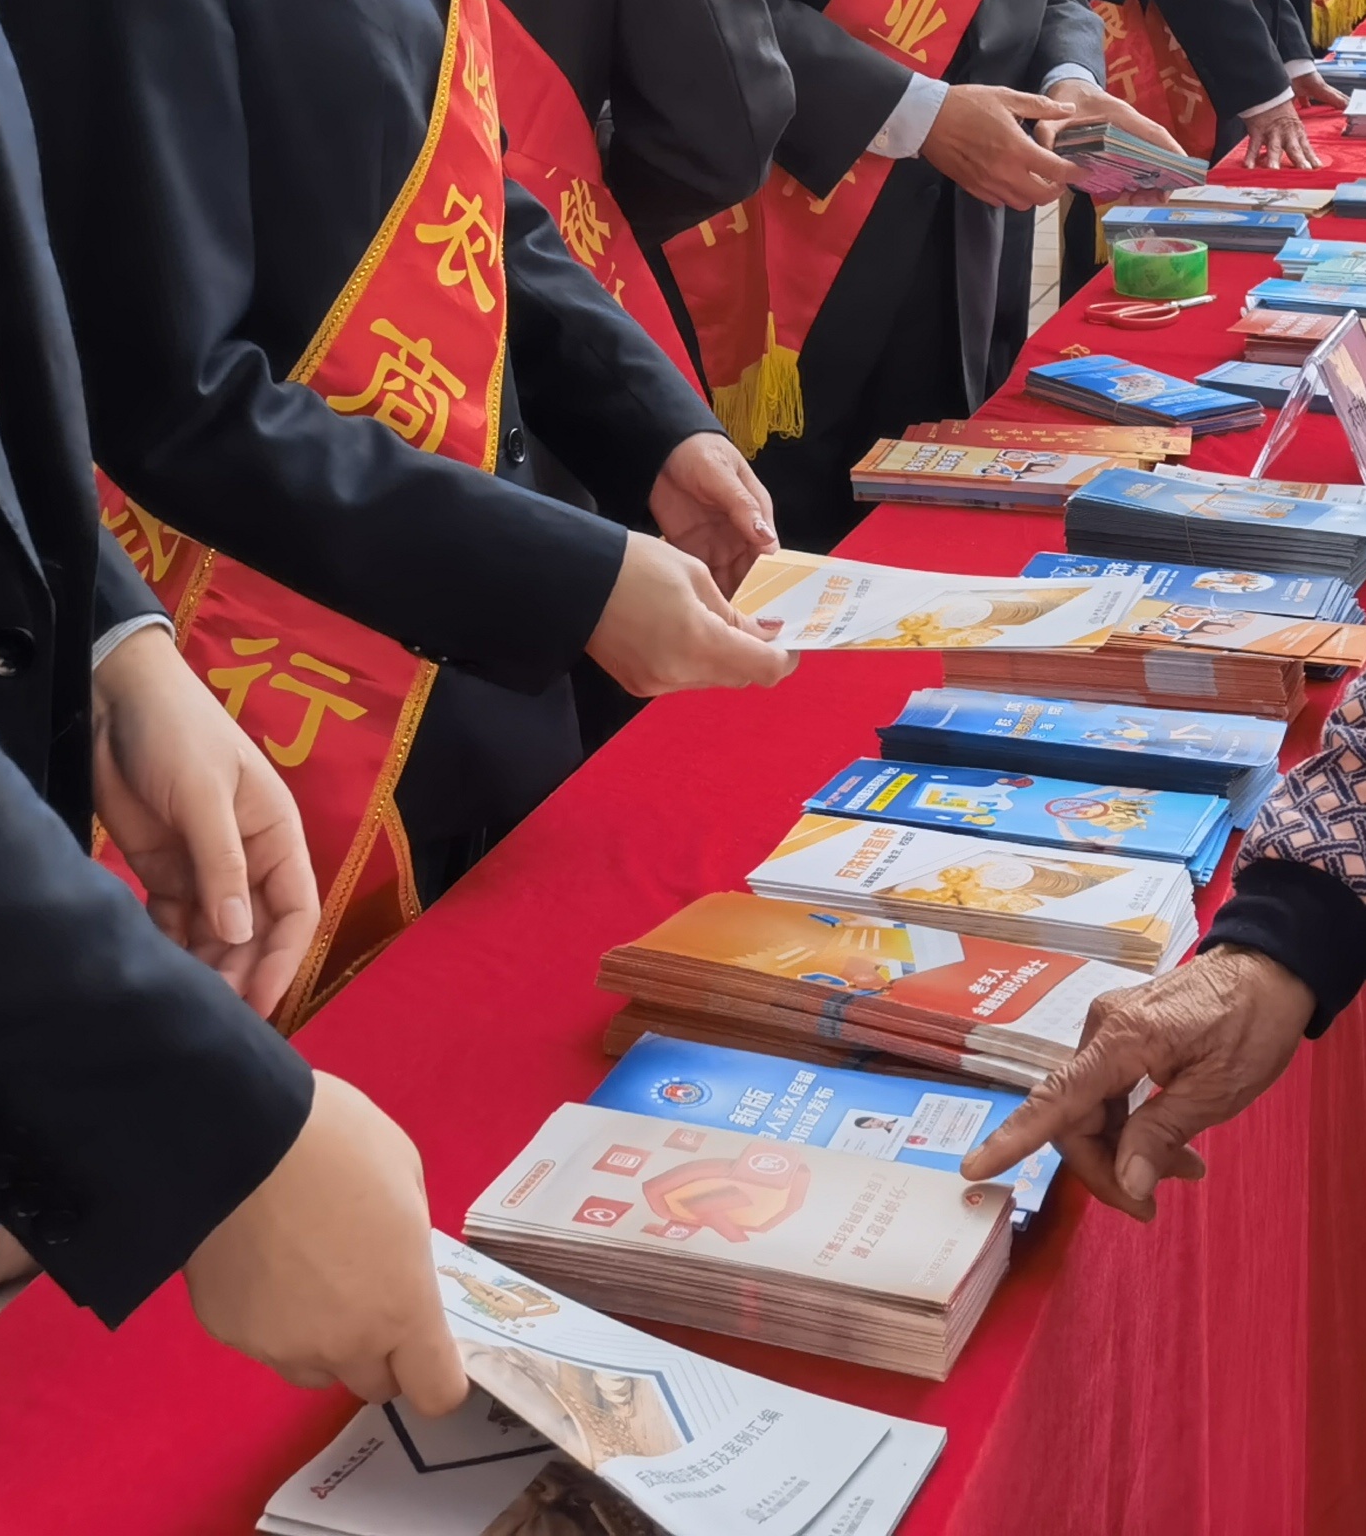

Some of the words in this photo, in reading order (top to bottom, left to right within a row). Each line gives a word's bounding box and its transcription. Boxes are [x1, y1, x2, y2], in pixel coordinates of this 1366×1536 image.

[209, 637, 368, 767] 行
[835, 827, 898, 879] 反洗钱宣传
[969, 967, 1009, 995] 老年人
[972, 959, 1049, 1017] 金融知识小贴士
[727, 1087, 776, 1128] 新版
